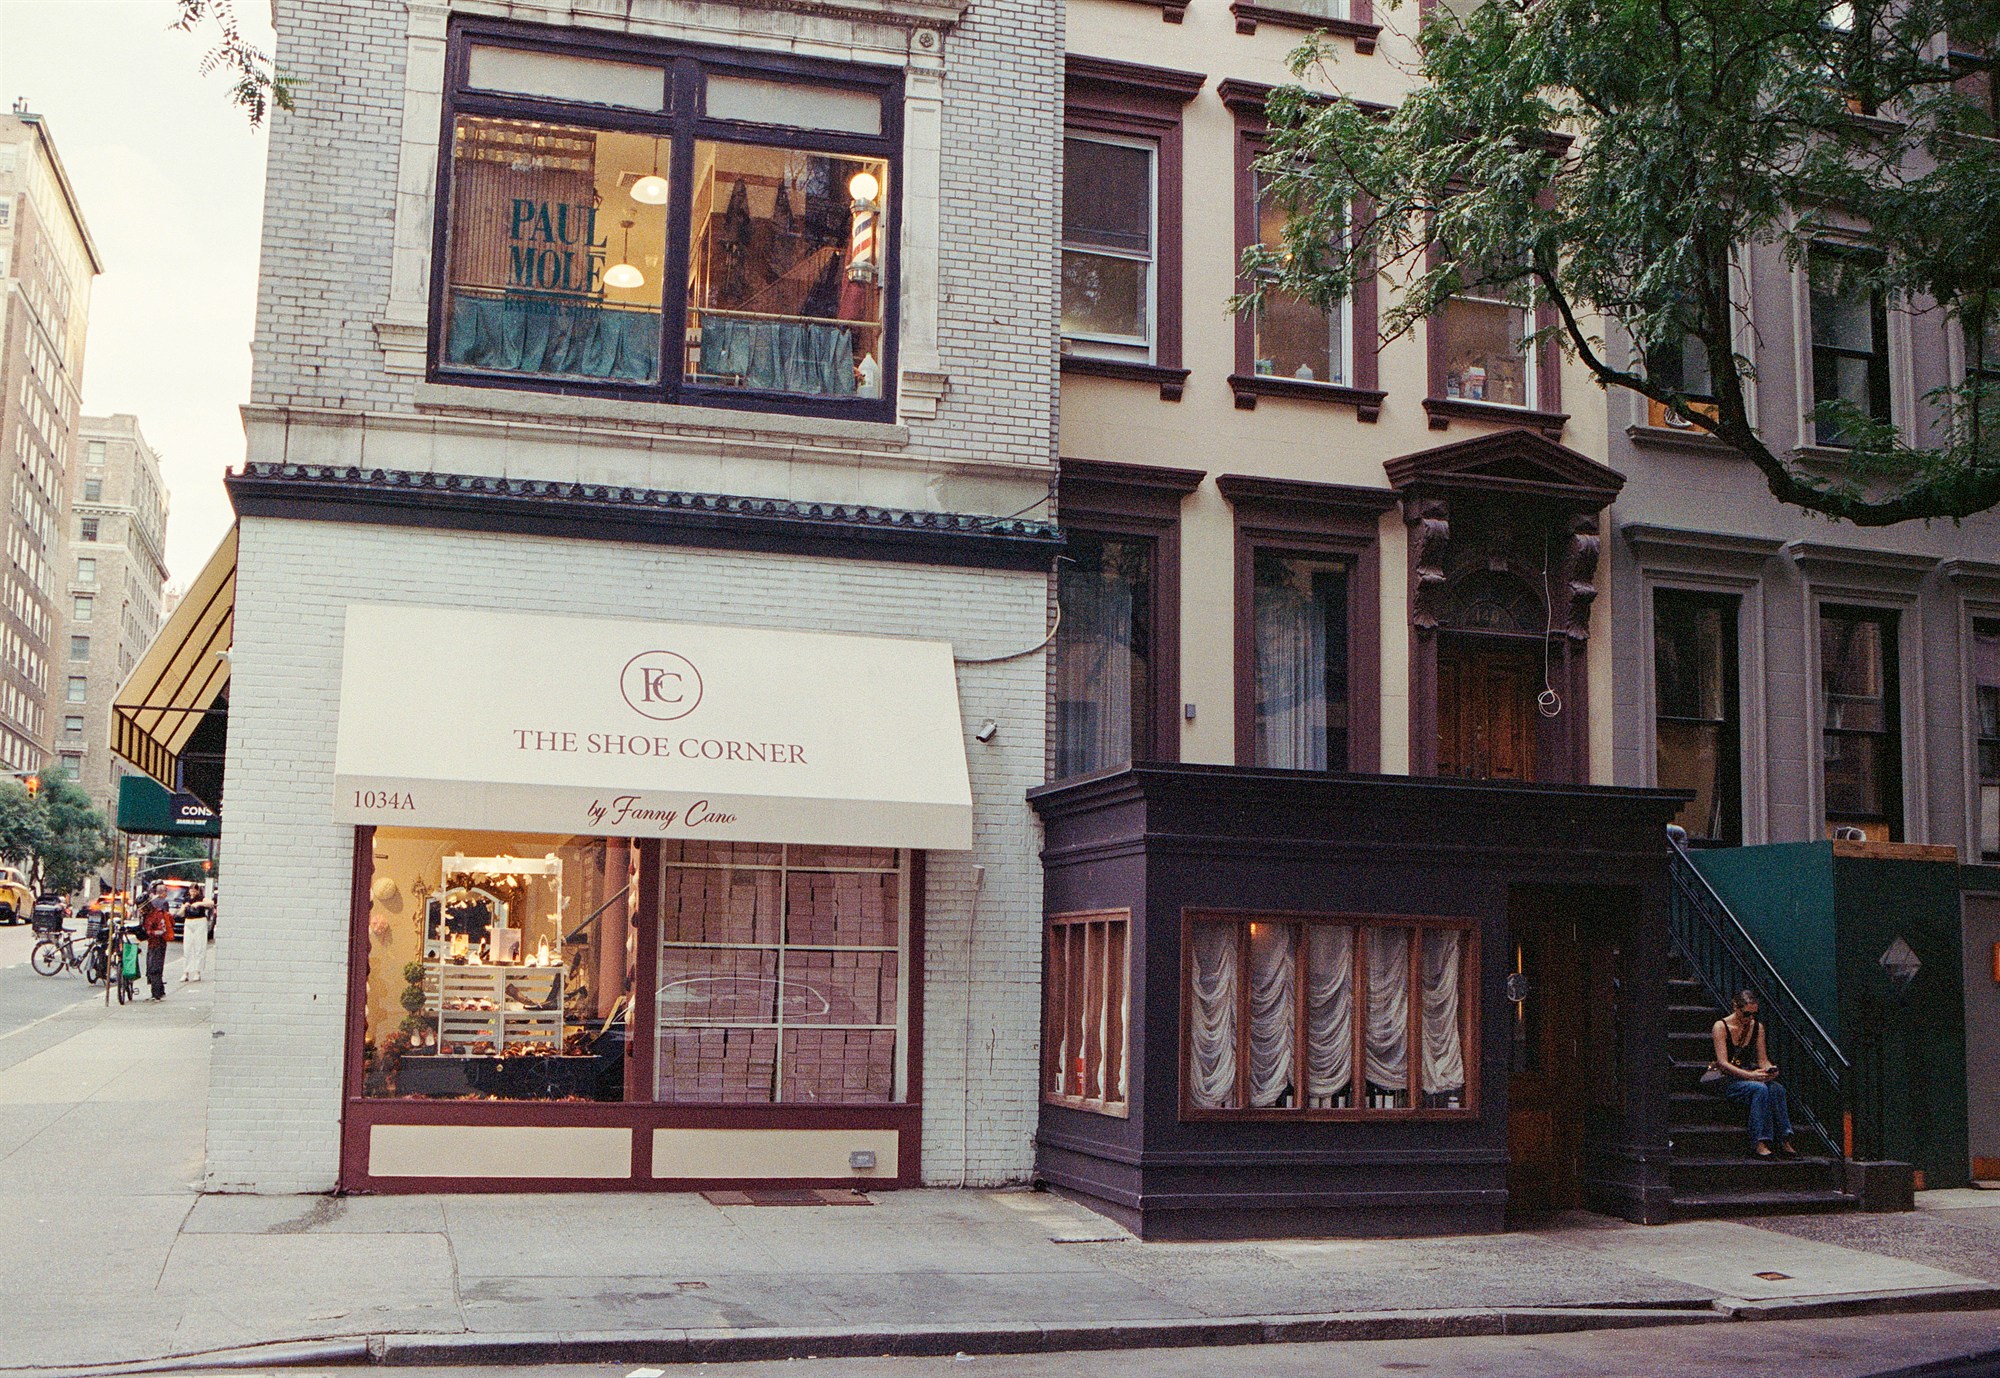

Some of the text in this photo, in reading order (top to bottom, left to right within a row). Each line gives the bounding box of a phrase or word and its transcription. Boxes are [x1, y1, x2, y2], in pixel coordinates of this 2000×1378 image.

[509, 199, 608, 247] PAUL
[513, 729, 807, 764] THE SHOE CORNER
[354, 790, 416, 810] 1034A
[587, 795, 738, 831] by Fanny Cano
